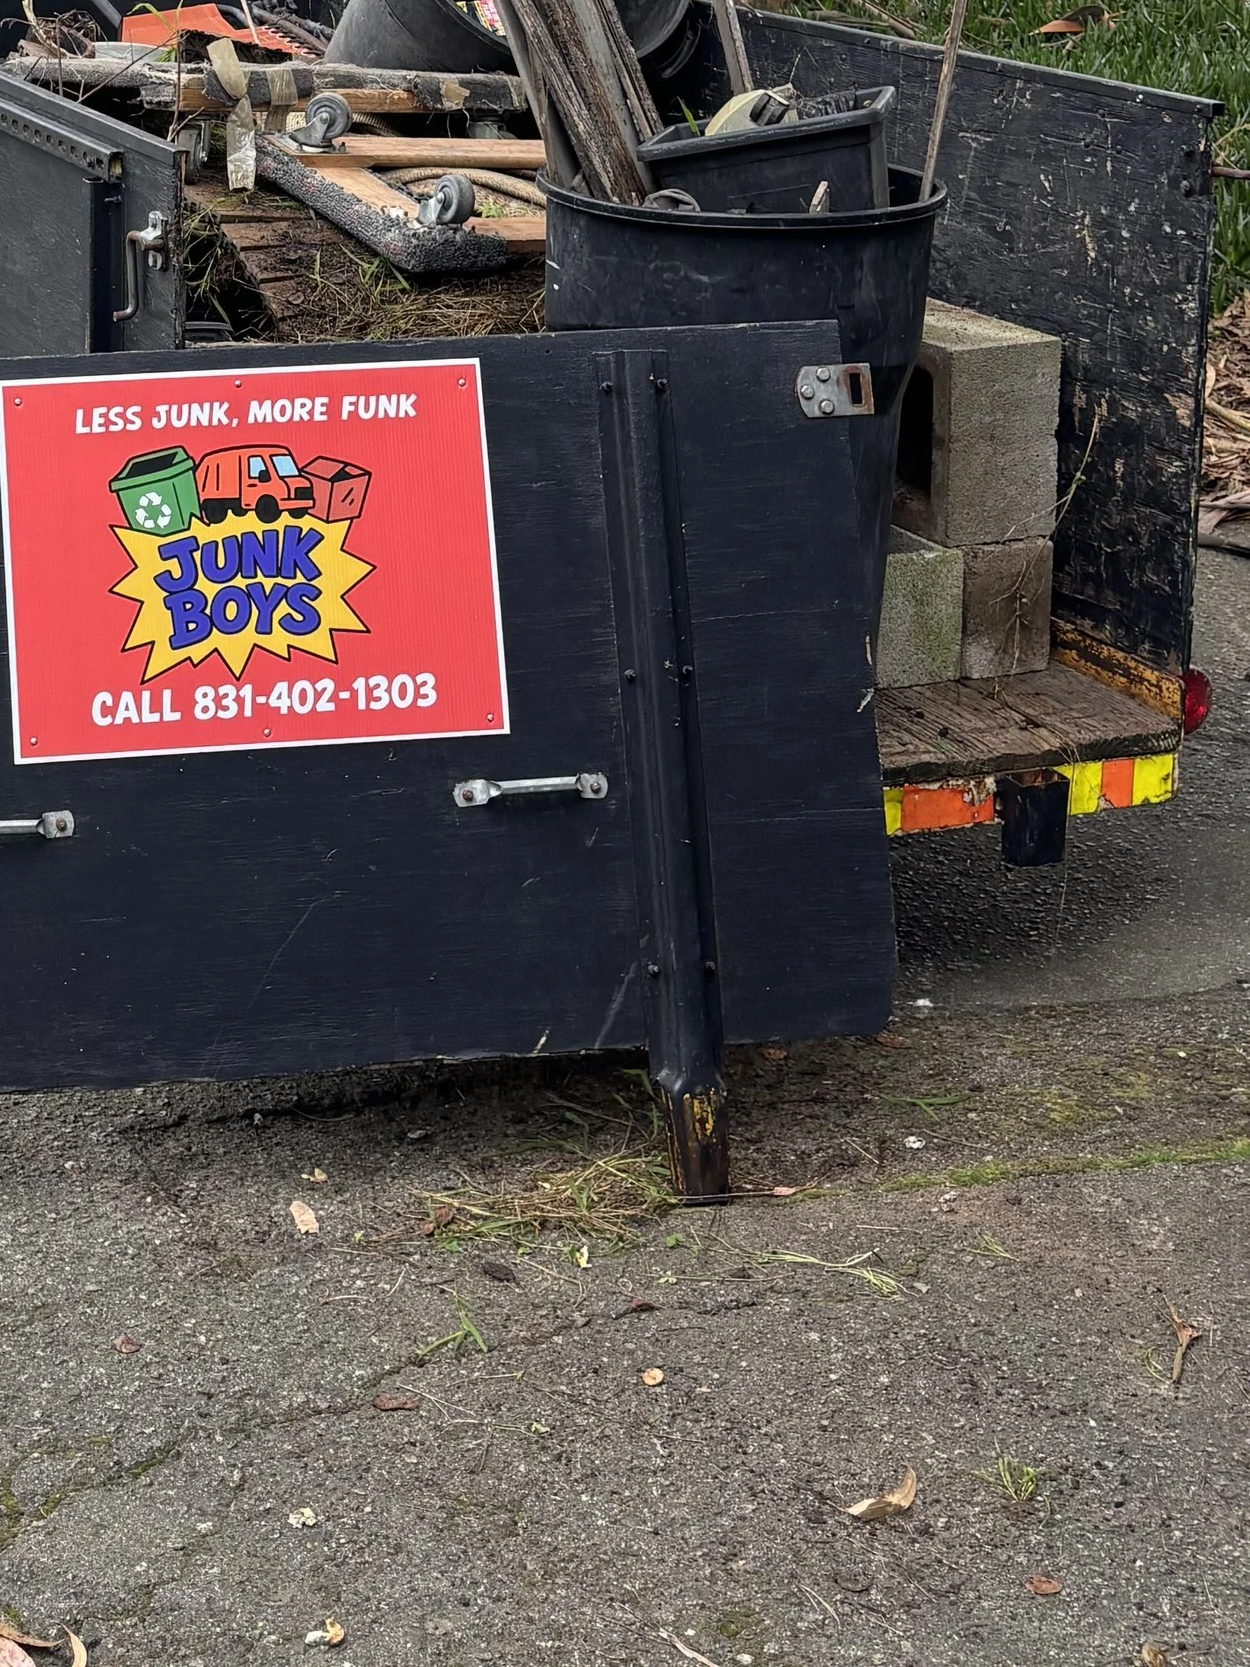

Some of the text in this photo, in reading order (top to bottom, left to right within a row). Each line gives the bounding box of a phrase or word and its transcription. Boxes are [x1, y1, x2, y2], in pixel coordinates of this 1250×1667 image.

[75, 393, 417, 434] LESS JUNK, MORE FUNK
[154, 526, 324, 593] JUNK
[163, 582, 322, 650] BOYS
[92, 673, 438, 726] CALL 831-402-1303
